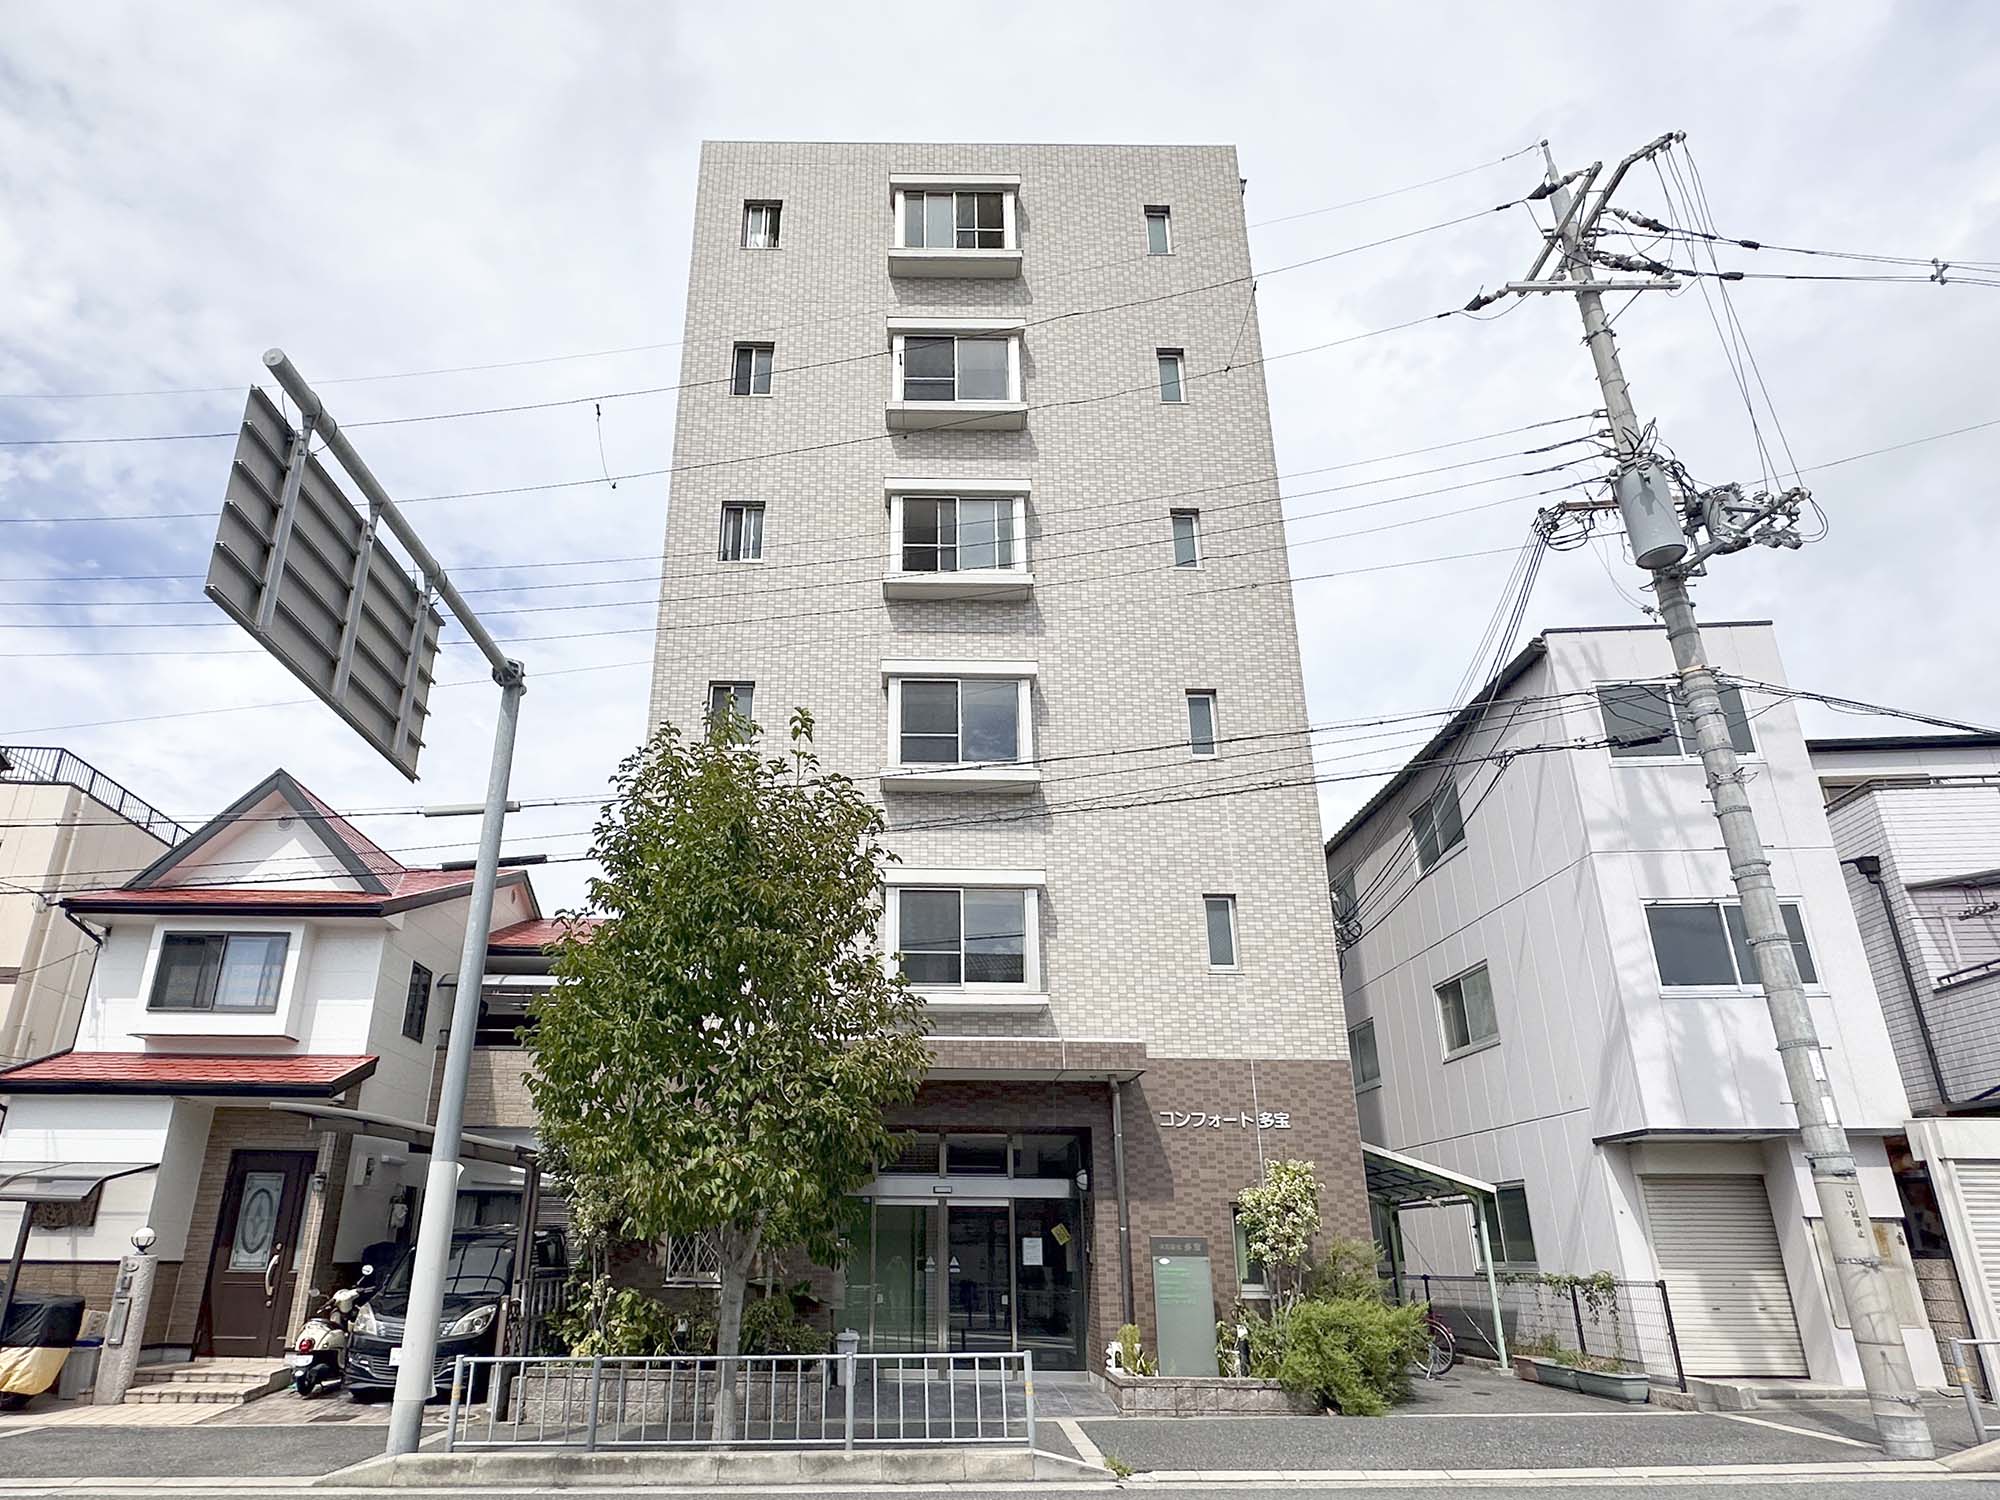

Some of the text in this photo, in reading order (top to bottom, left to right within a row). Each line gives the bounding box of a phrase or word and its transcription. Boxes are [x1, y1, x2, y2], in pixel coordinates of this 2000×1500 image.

[1159, 1111, 1292, 1130] コンフォート多宝
